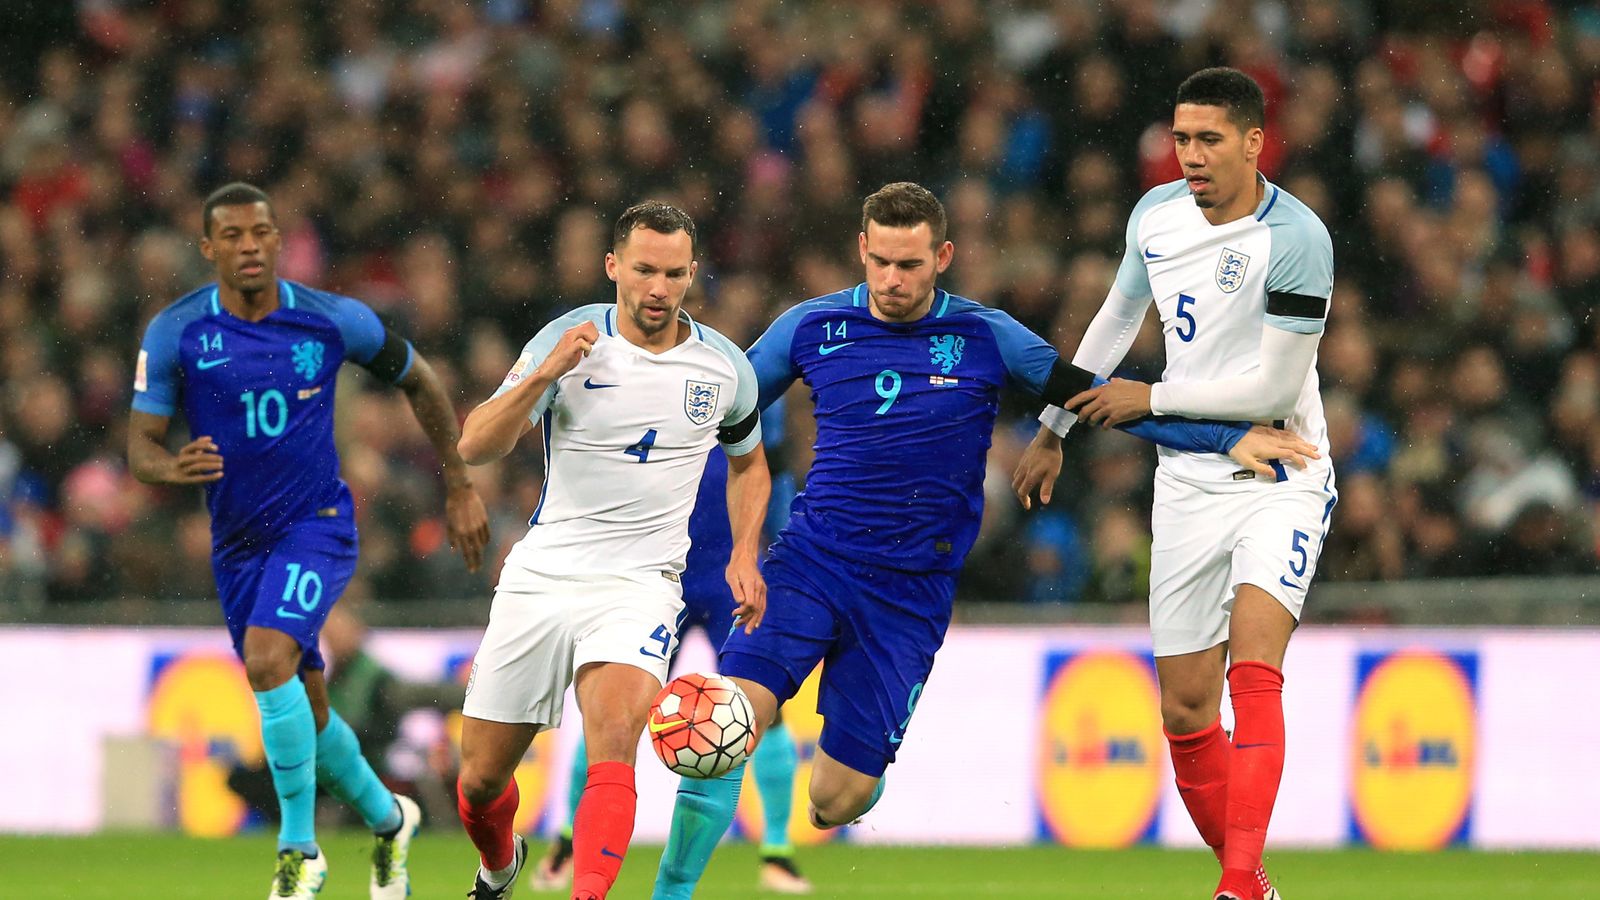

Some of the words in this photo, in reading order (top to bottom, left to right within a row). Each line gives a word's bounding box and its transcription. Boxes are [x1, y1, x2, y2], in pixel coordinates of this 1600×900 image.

[822, 321, 847, 340] 14
[1176, 294, 1196, 342] 5
[200, 332, 223, 352] 14
[240, 389, 287, 437] 10
[875, 370, 902, 415] 9
[624, 429, 657, 463] 4
[1289, 529, 1309, 577] 5
[281, 563, 323, 612] 10
[649, 624, 671, 656] 4
